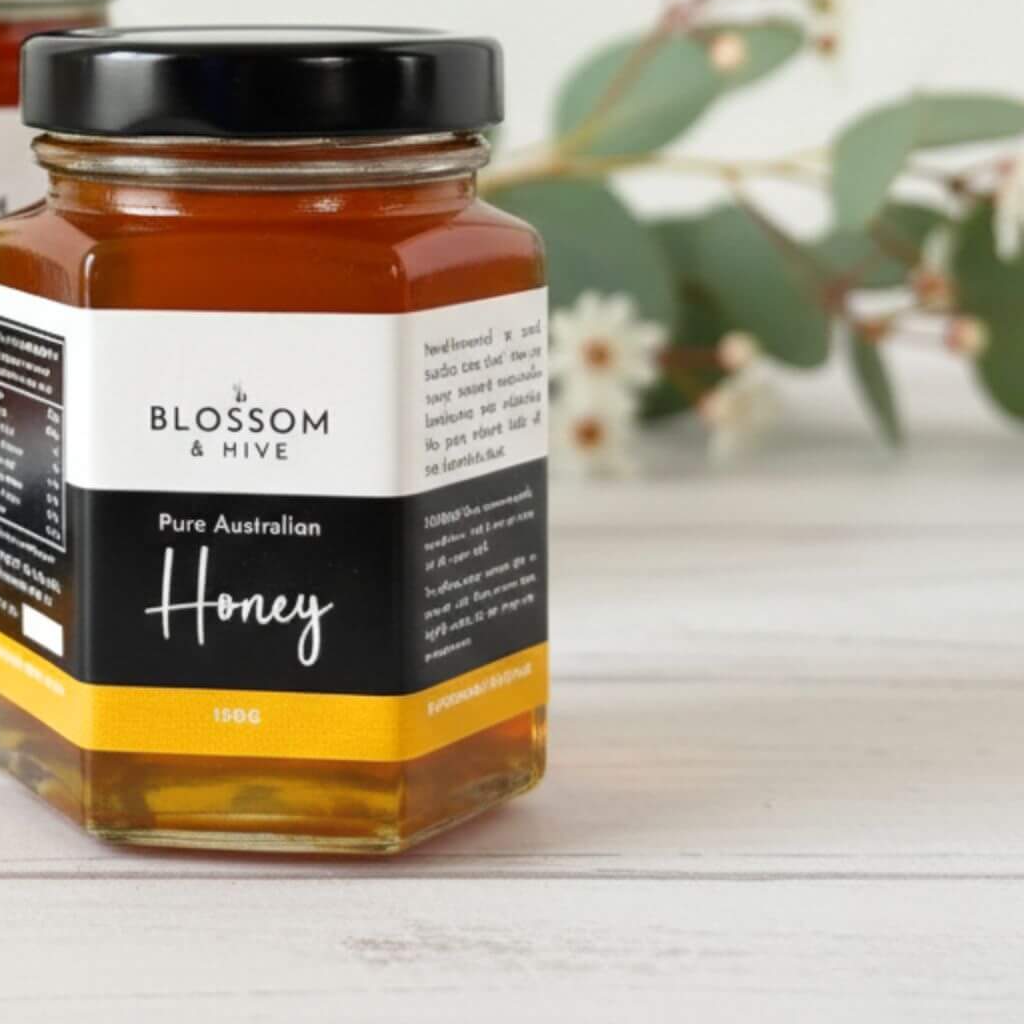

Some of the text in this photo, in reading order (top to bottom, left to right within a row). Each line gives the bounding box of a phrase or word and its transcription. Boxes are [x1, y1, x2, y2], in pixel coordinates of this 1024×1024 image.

[149, 405, 330, 435] BLOSSOM
[190, 439, 289, 460] & HIVE
[158, 512, 321, 537] Pure Australian
[144, 545, 335, 667] Honey
